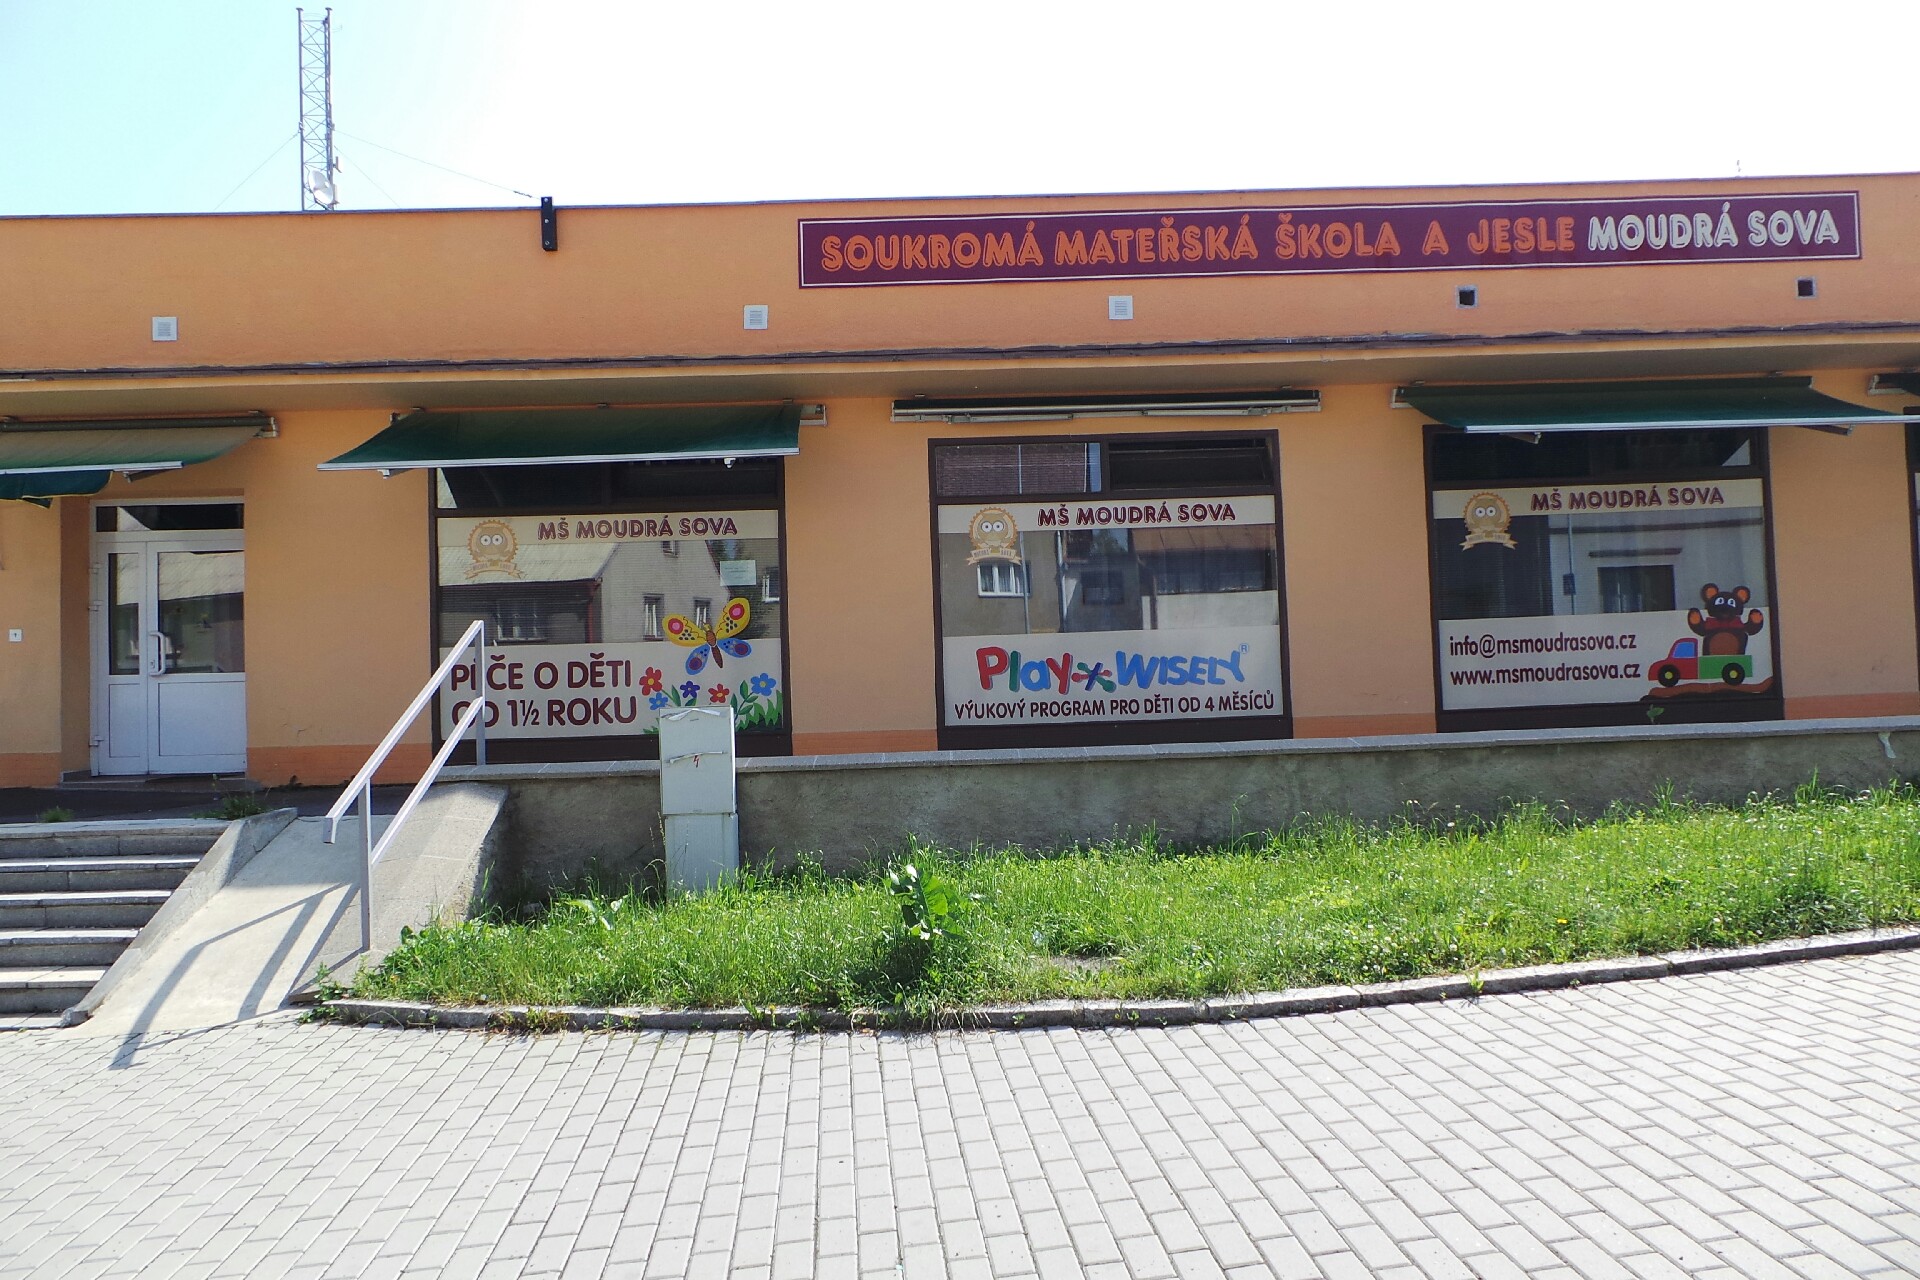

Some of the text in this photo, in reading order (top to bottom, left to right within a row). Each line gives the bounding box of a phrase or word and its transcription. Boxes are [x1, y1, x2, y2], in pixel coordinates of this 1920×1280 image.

[821, 202, 1840, 272] SOUKROMÁ MATEŘSKÁ ŠKOLA A JESLE MOUDRÁ SOVA
[1530, 485, 1725, 511] MŠ MOUDRÁ SOVA
[1038, 501, 1236, 527] MŠ MOUDRÁ SOVA
[537, 515, 738, 541] MŠ MOUDRÁ SOVA
[1449, 631, 1637, 658] info@msmoudrasova.cz
[533, 661, 559, 689] O
[567, 652, 632, 688] DĚTI
[1450, 662, 1641, 685] www.msmoudrasova.cz
[547, 696, 637, 726] ROKU
[955, 690, 1275, 720] VÝUKOVÝ PROGRAM PRO DĚTI OD 4 MĚSÍCŮ
